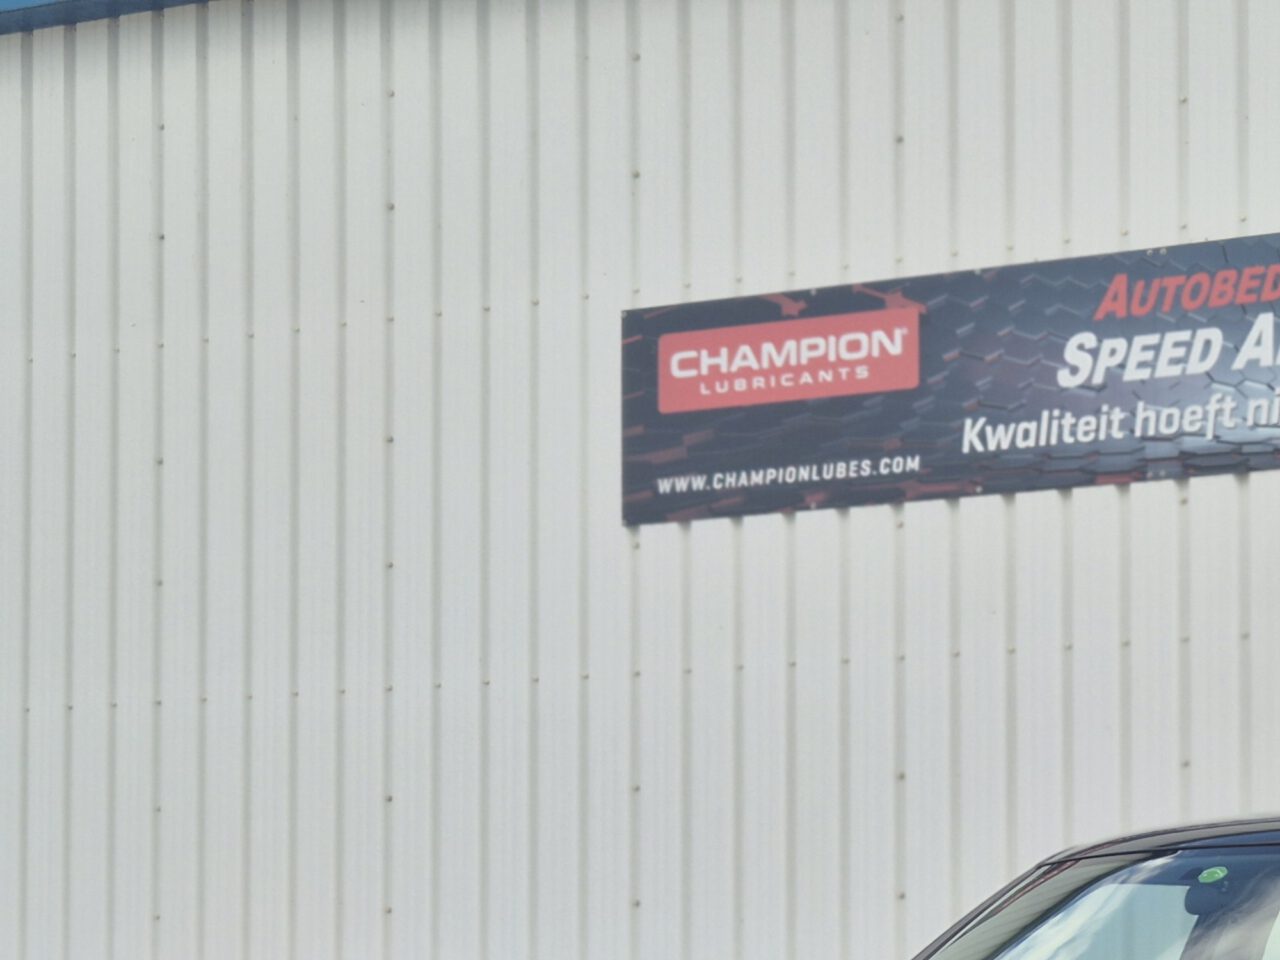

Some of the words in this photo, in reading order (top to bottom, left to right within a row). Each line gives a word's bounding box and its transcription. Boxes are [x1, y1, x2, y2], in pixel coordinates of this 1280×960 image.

[670, 328, 904, 379] CHAMPION
[1056, 327, 1223, 389] SPEED
[700, 365, 870, 395] LUBRICANTS
[962, 403, 1125, 454] Kwaliteit
[1134, 396, 1237, 441] hoeft
[658, 455, 921, 495] WWW.CHAMPIONLUBES.COM
